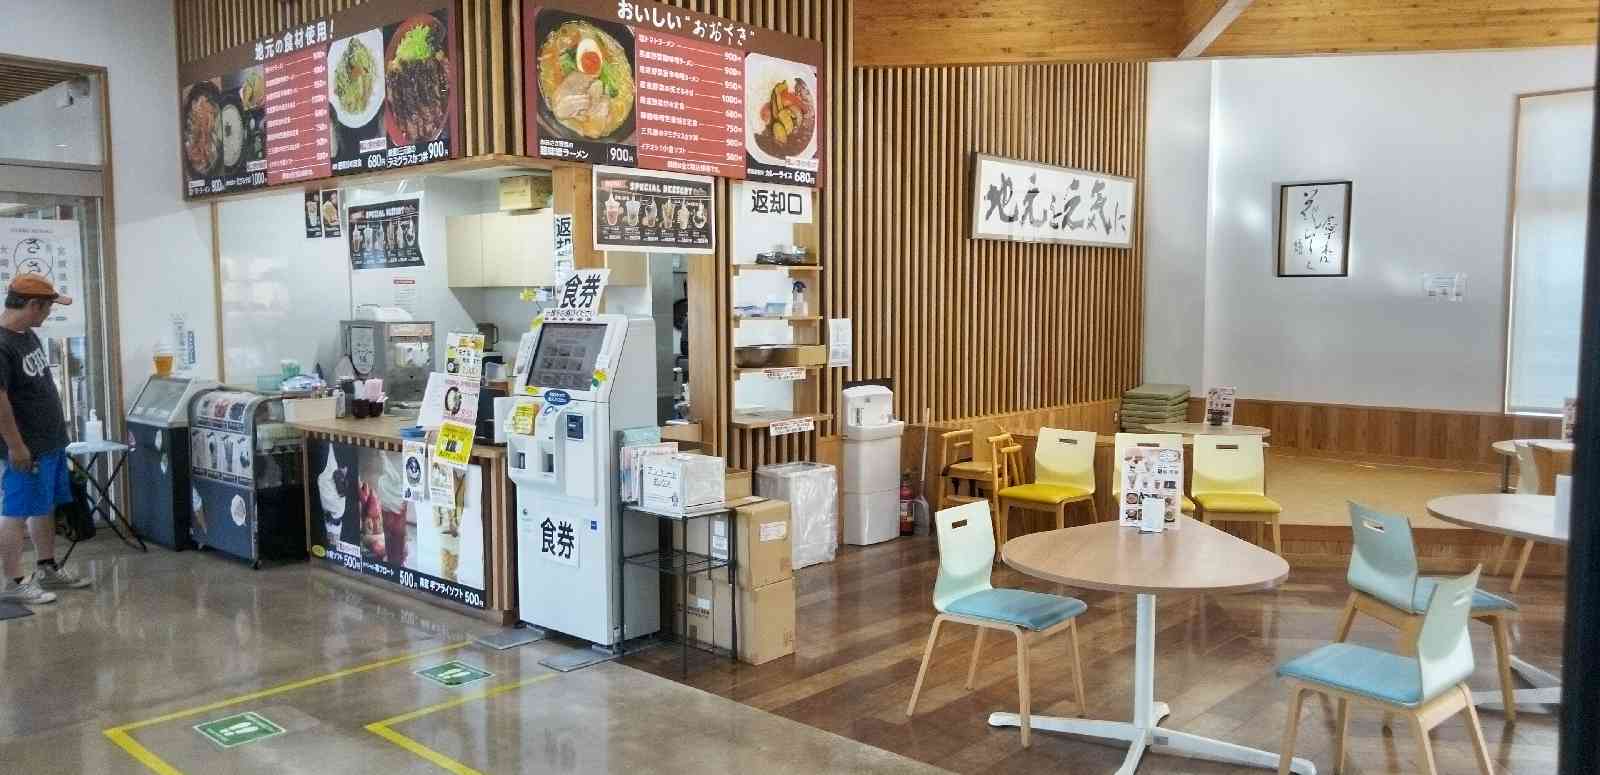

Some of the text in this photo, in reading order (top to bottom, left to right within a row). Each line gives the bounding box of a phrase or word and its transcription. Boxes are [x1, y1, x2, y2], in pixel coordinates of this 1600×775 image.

[428, 140, 449, 159] 900円
[610, 148, 634, 162] 900円
[765, 169, 792, 179] カレーライス
[794, 171, 816, 184] 680円
[629, 182, 661, 192] SPECIAL
[752, 190, 802, 216] 返却口
[560, 274, 600, 308] 食券
[540, 517, 575, 559] 食券
[400, 570, 418, 589] 500円
[465, 591, 484, 608] 500円
